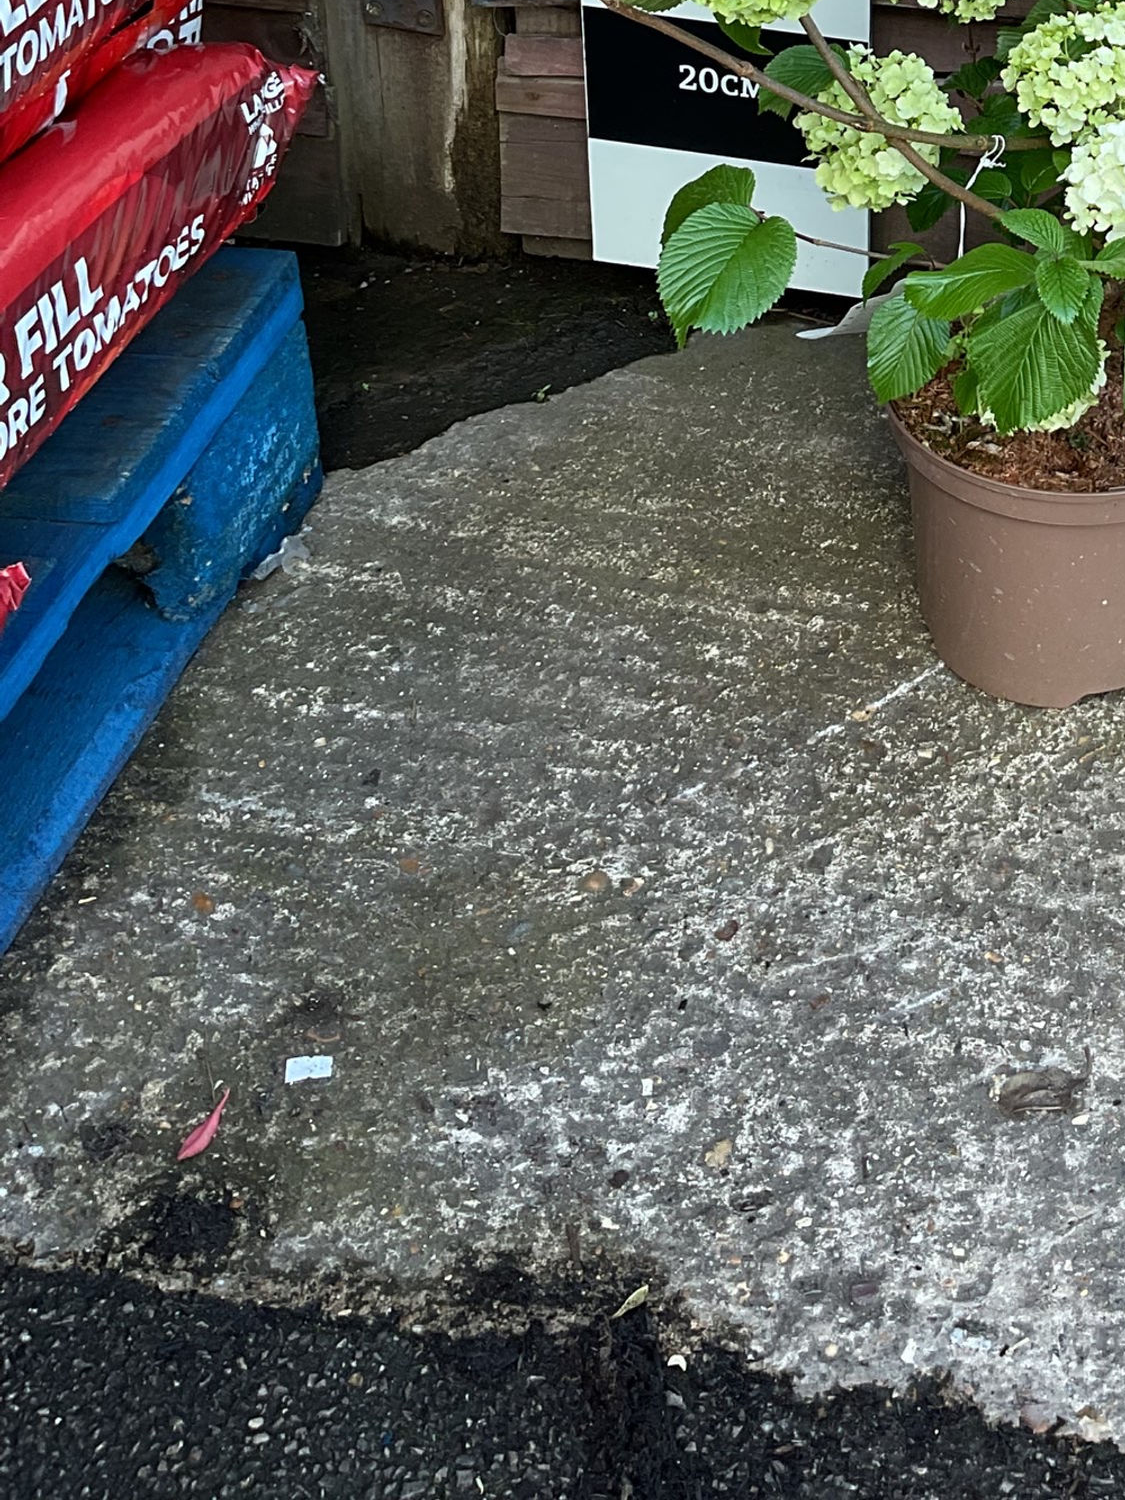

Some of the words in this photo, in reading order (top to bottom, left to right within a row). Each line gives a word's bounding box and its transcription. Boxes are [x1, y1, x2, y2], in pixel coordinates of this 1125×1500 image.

[678, 64, 760, 99] 20CM
[14, 257, 104, 380] FILL
[53, 214, 205, 392] TOMATOES
